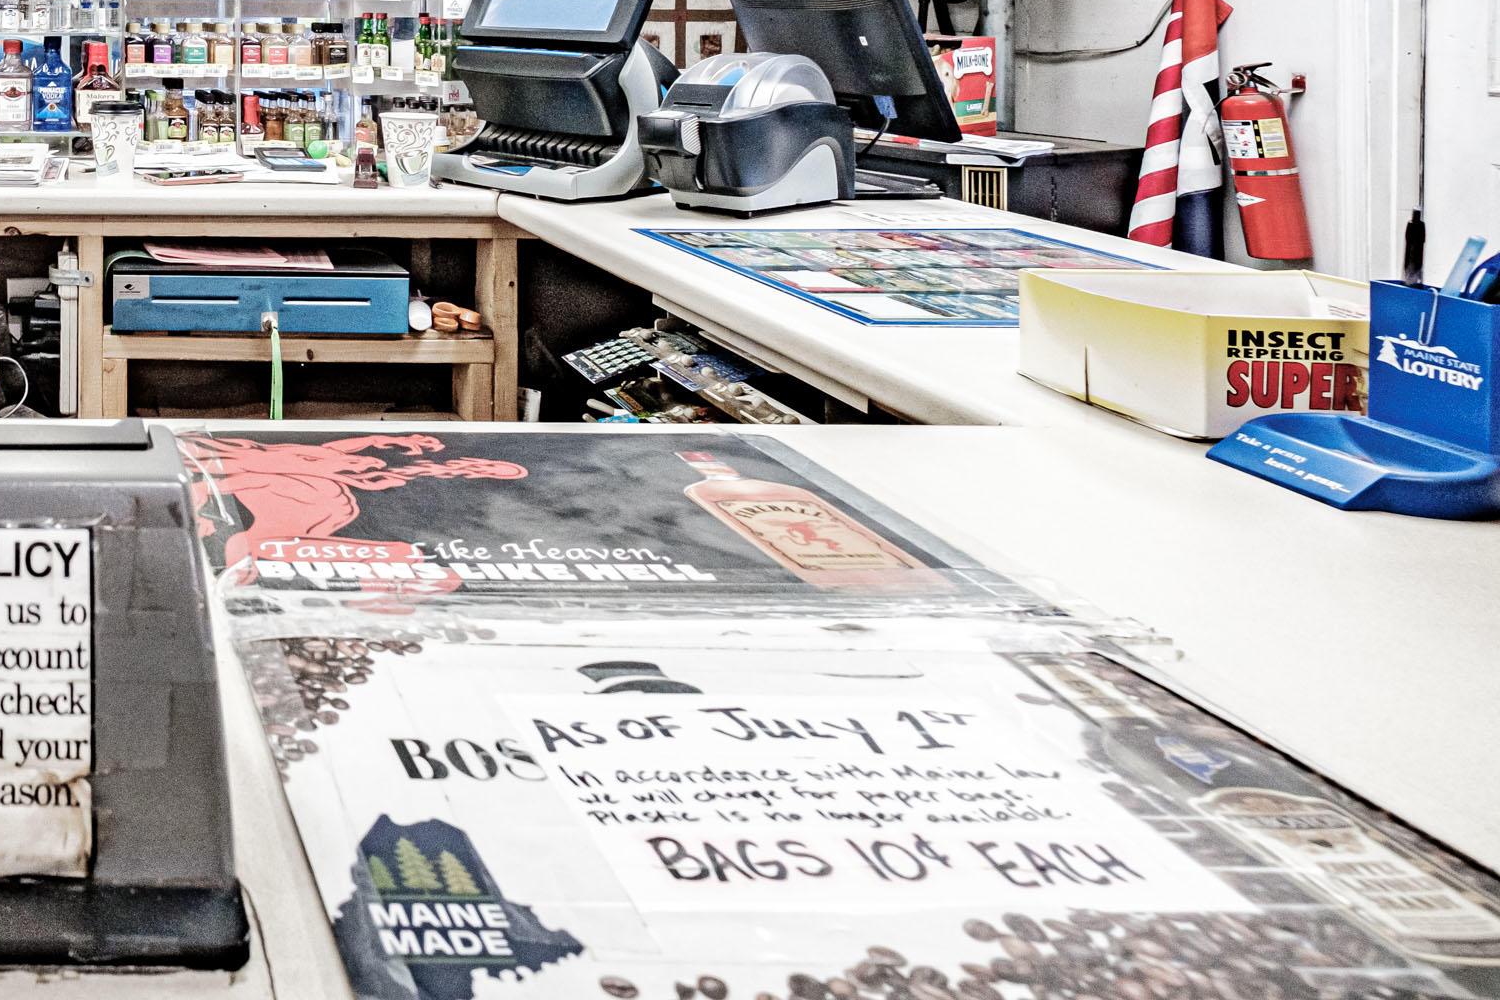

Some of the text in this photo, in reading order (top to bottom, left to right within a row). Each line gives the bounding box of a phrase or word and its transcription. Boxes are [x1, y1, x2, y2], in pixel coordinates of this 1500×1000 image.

[956, 53, 989, 71] MILK-BONE
[1227, 329, 1345, 350] INSECT
[1227, 348, 1344, 361] REPELLING
[1403, 349, 1481, 374] MAINE STATE
[1226, 360, 1362, 411] SUPER
[1402, 358, 1484, 391] LOTTERY
[1235, 432, 1262, 448] Take
[1271, 445, 1307, 464] penny
[1264, 457, 1293, 473] leave
[735, 503, 829, 519] FIREBALL
[259, 537, 673, 564] Tastes Like Heaven,
[256, 559, 719, 582] BURNS LIKE HELL
[5, 602, 41, 625] us
[60, 596, 88, 625] to
[0, 682, 88, 716] check
[532, 718, 607, 753] AS
[616, 714, 682, 740] OF
[697, 706, 884, 755] JULY
[15, 737, 88, 767] your
[558, 762, 1061, 788] In accordance with Maine law
[578, 791, 619, 805] we
[631, 789, 684, 804] will
[693, 788, 778, 806] charge
[791, 785, 838, 801] for
[857, 788, 941, 807] paper
[759, 810, 803, 823] no
[816, 808, 905, 829] longer
[645, 836, 834, 883] BAGS
[967, 841, 1147, 889] EACH
[367, 902, 510, 928] MAINE
[378, 929, 513, 956] MADE
